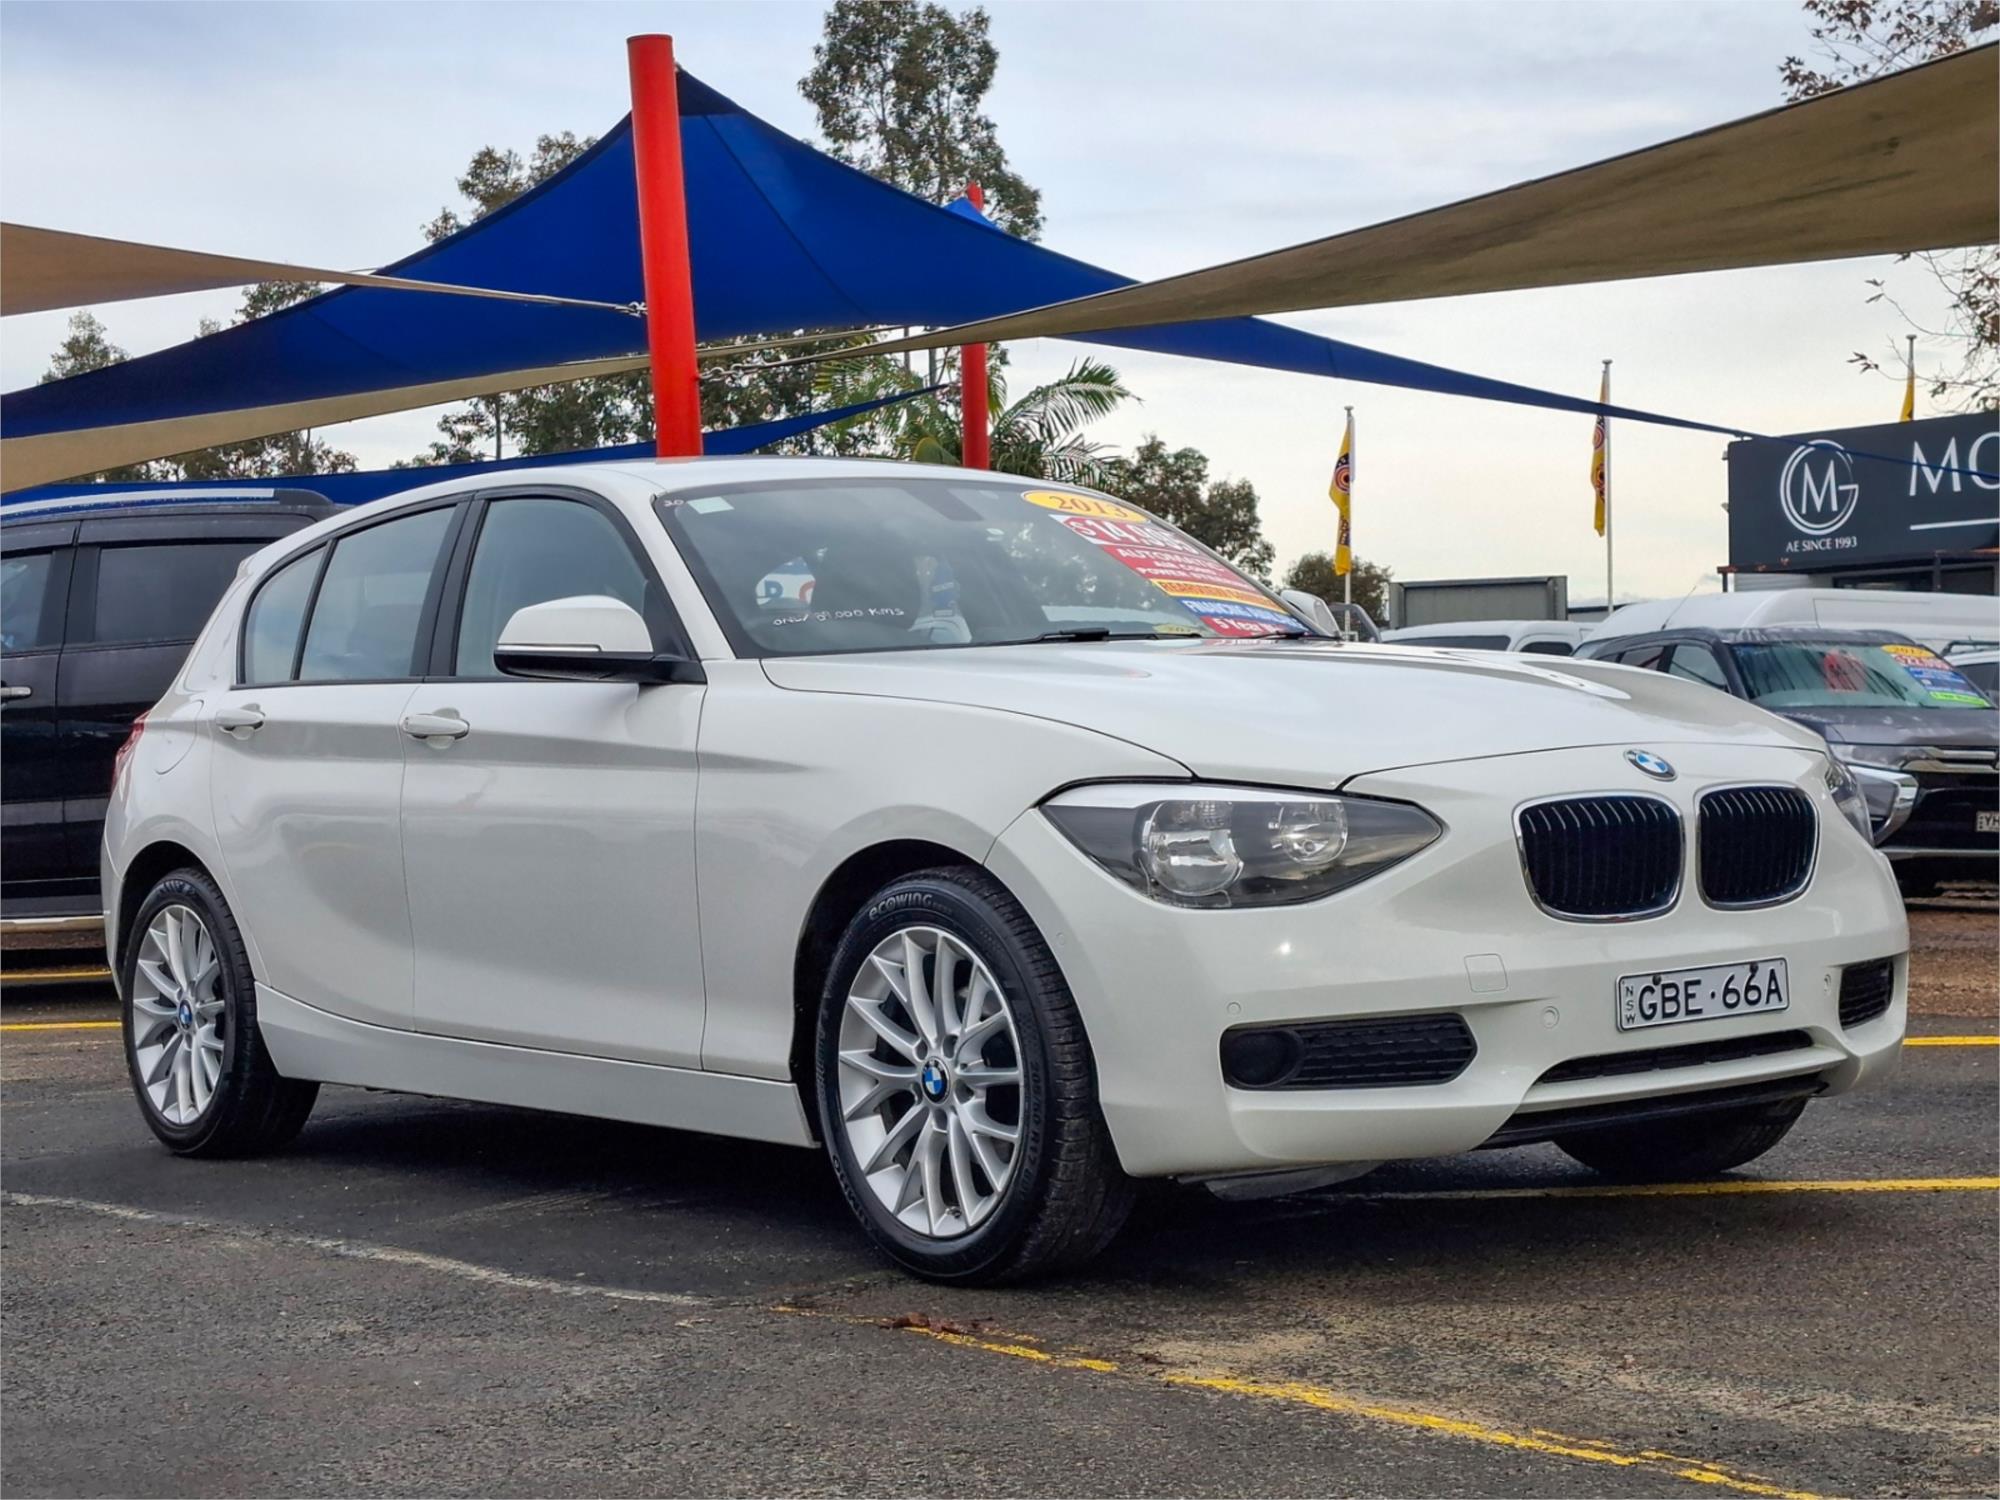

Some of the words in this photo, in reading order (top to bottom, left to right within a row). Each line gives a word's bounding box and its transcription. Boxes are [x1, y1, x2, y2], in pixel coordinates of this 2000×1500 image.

[1049, 495, 1128, 518] 2013
[1786, 540, 1800, 552] AE
[1802, 538, 1832, 551] SINCE
[1834, 536, 1857, 549] 1993
